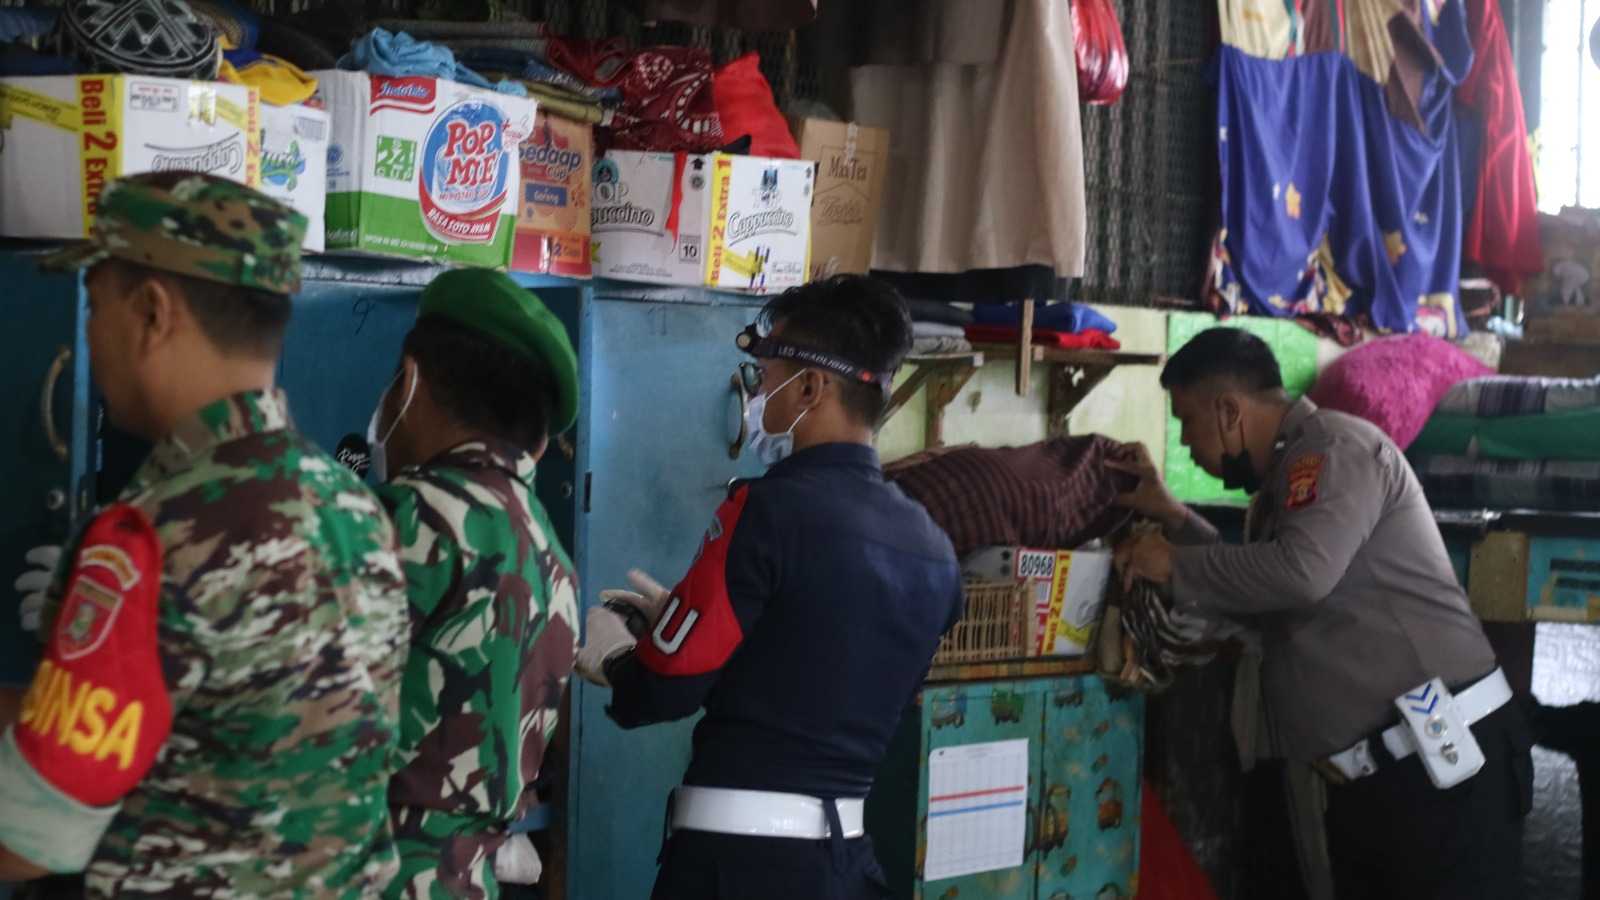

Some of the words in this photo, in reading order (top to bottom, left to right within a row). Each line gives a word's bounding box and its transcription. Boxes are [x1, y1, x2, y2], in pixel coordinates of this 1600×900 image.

[81, 79, 106, 126] Beli
[84, 131, 118, 152] 2
[447, 153, 498, 187] MIE
[717, 159, 732, 170] 1
[712, 225, 725, 240] 2
[683, 244, 698, 258] 10
[1020, 554, 1053, 576] 80968
[652, 597, 699, 655] U
